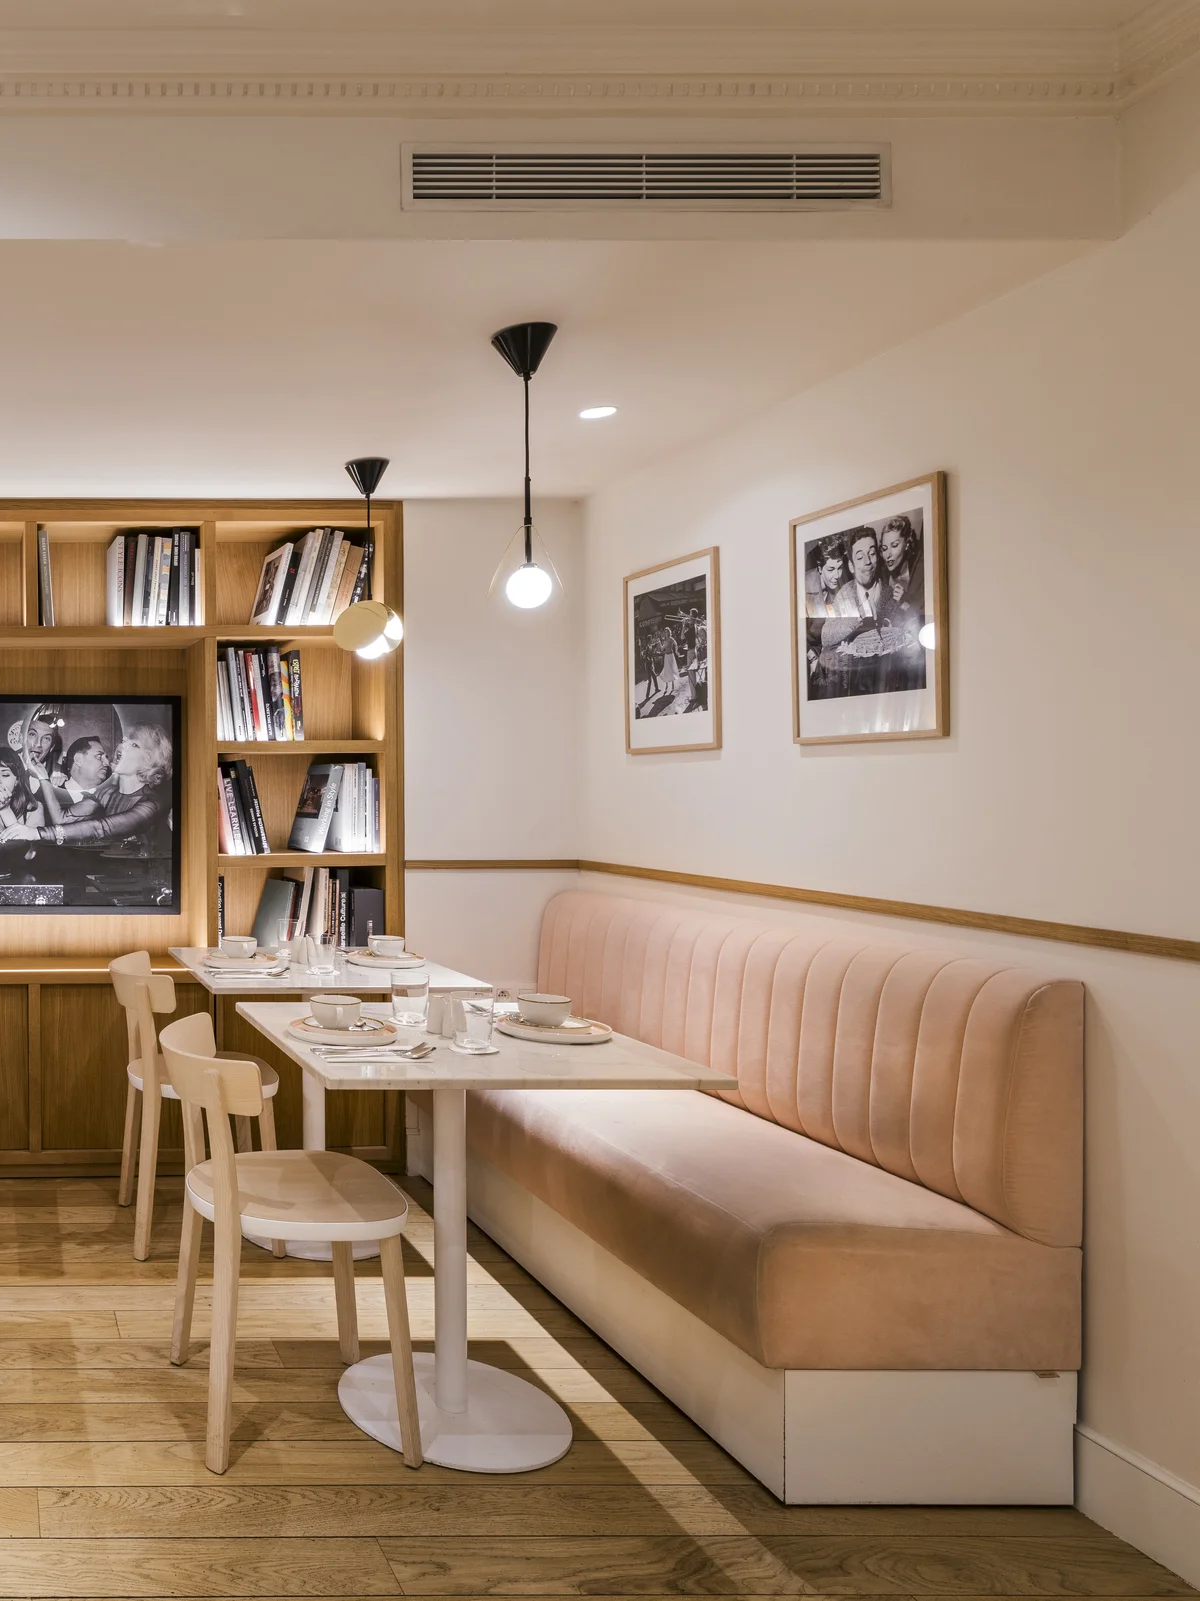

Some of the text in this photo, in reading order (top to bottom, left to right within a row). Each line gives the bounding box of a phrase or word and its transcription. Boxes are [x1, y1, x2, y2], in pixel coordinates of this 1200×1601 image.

[224, 779, 233, 798] LIVE
[228, 801, 239, 831] LEARN
[317, 808, 332, 835] Working
[327, 782, 337, 800] Style
